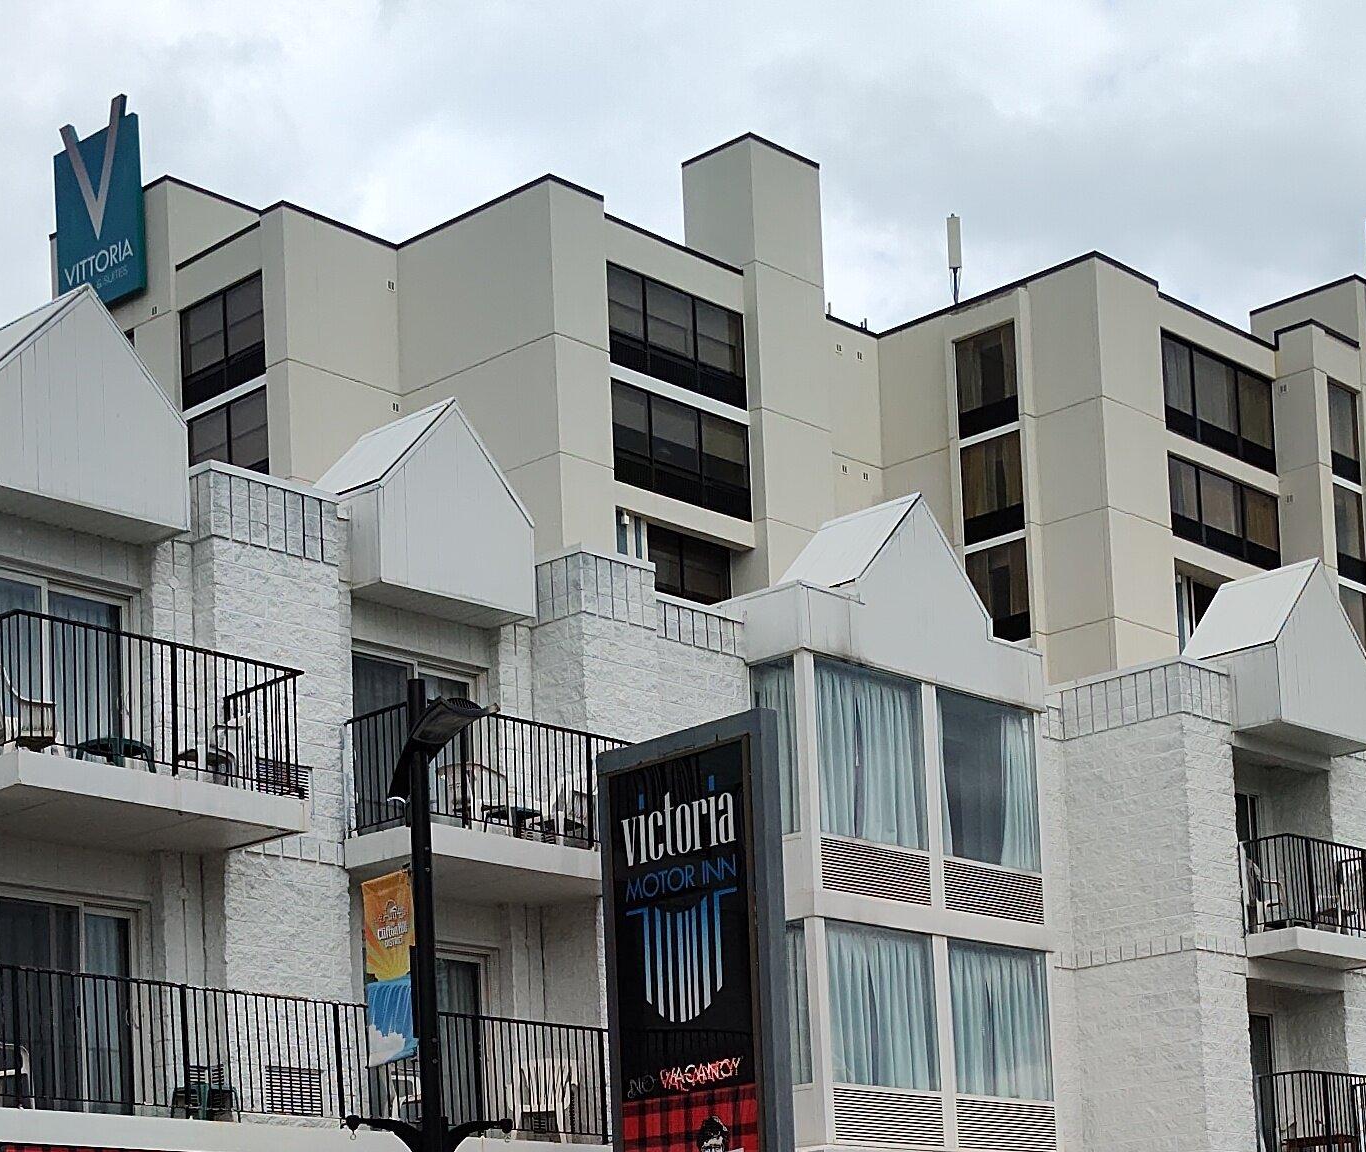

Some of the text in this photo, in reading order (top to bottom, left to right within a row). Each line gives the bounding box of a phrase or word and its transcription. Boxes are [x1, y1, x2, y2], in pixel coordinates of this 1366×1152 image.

[65, 238, 134, 287] VITTORIA
[622, 775, 738, 868] victoria
[626, 853, 738, 903] MOTOR INN
